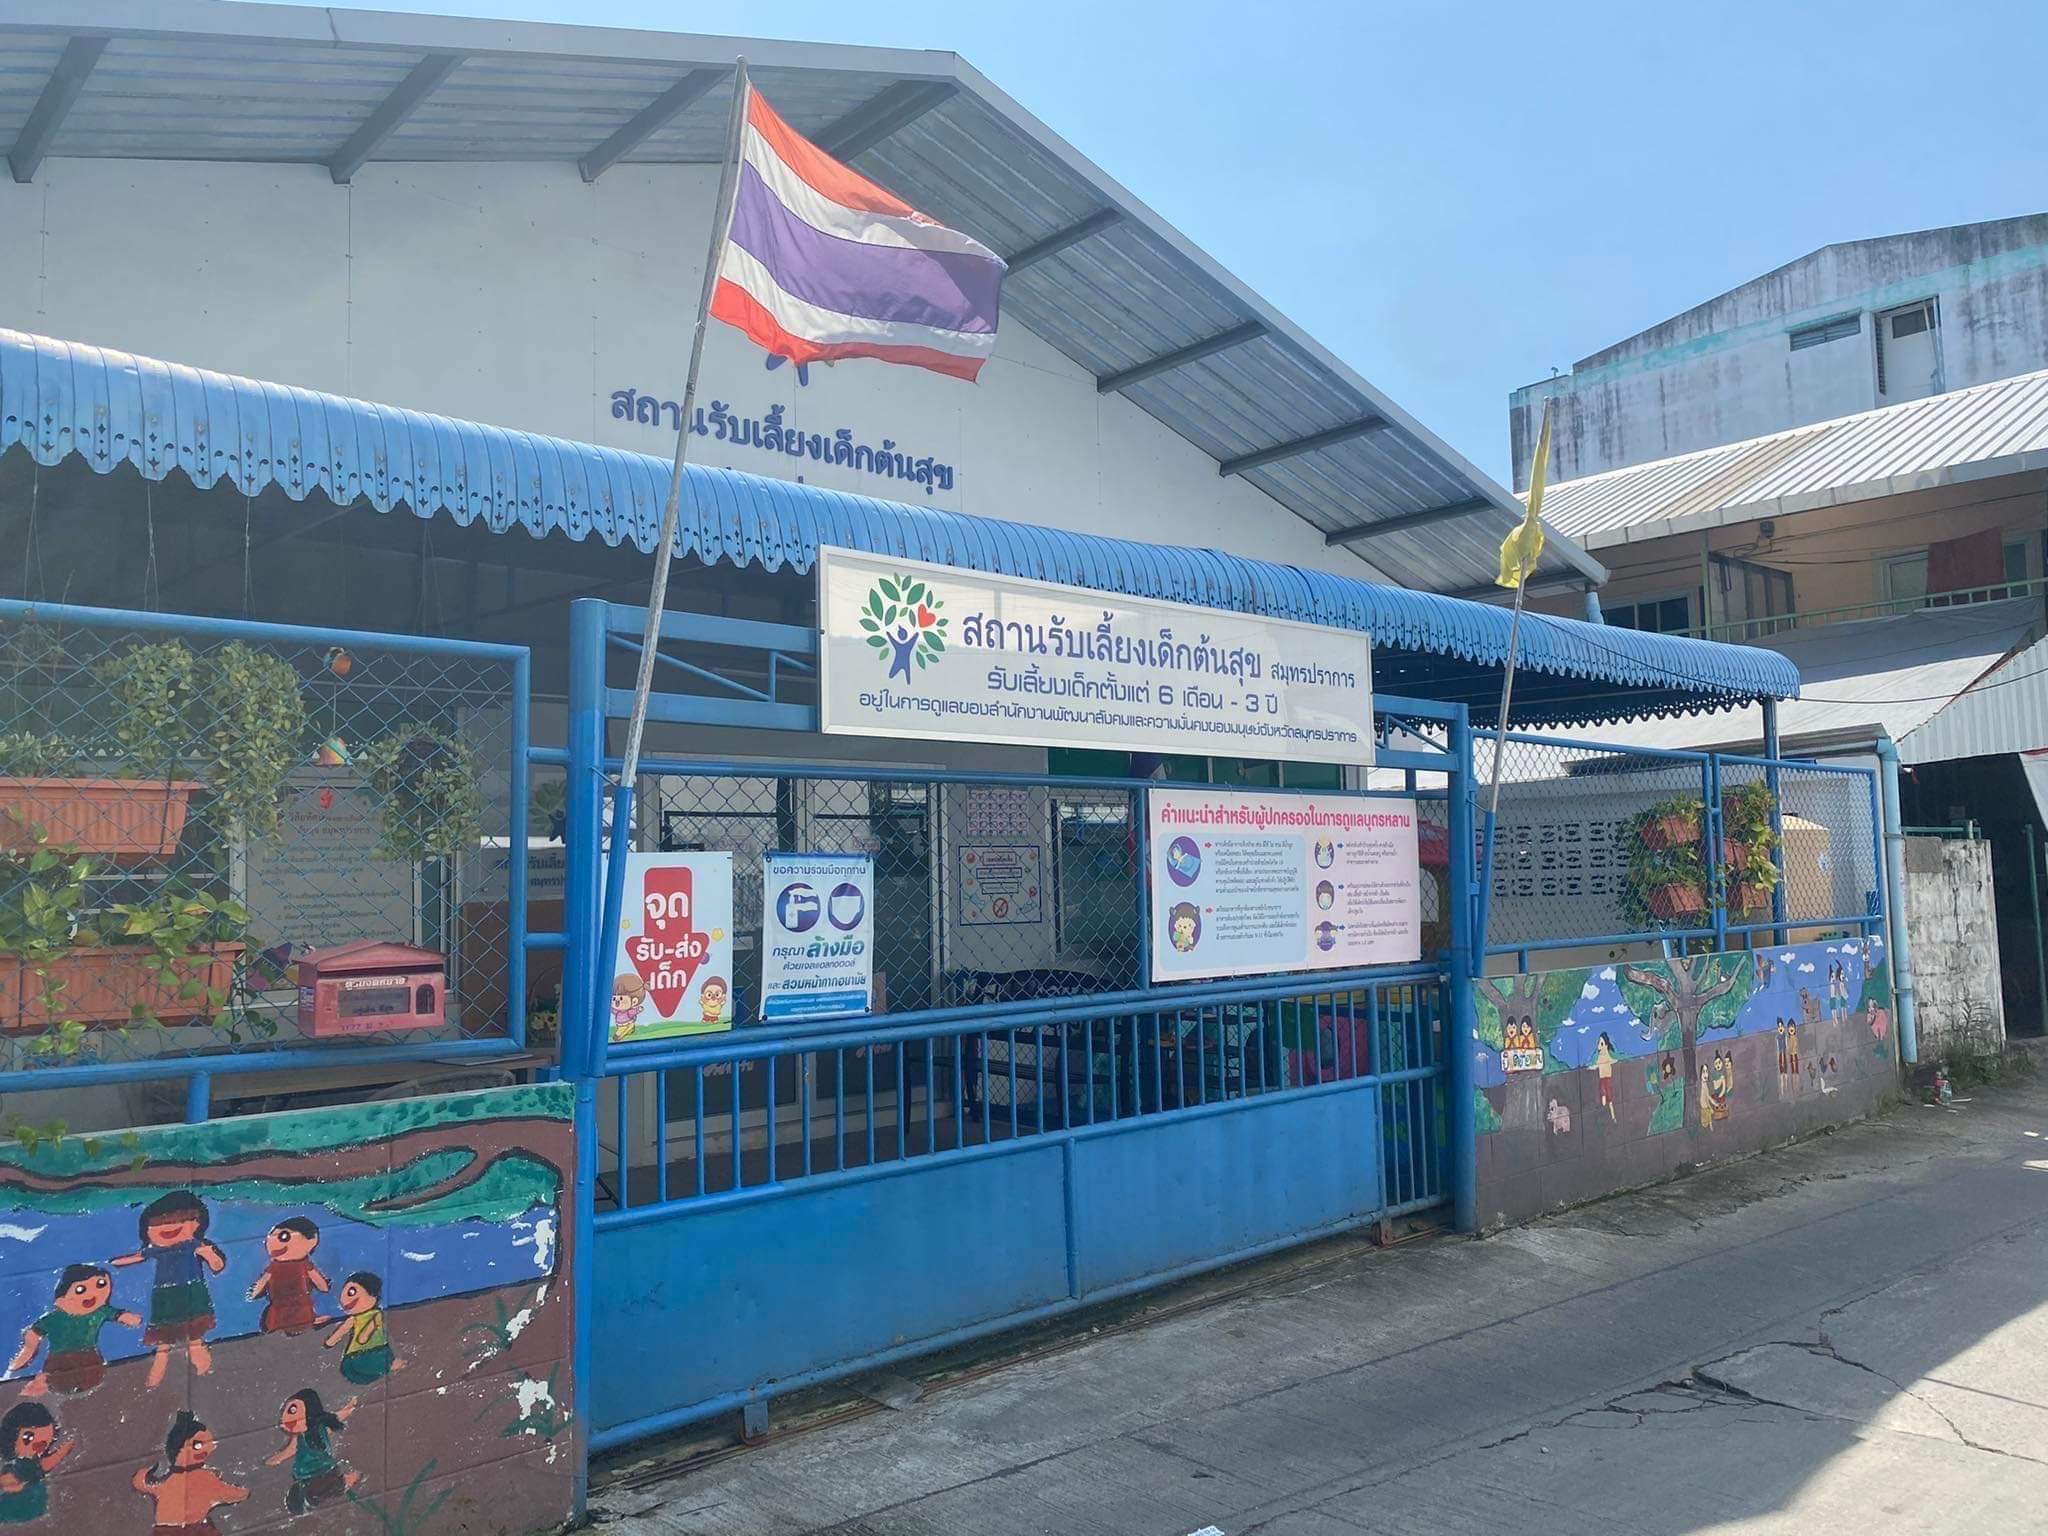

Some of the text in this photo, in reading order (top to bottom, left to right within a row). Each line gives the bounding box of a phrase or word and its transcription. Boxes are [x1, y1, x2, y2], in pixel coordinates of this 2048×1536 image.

[611, 387, 954, 495] สถานรับเลี้ยงเด็กต้นสุข
[962, 610, 1356, 689] สถานรับเลี้ยงเด็กต้นสุข สมุทรปราการ
[987, 663, 1150, 704] รับเลี้ยงเด็กตั้งแต่
[1159, 685, 1174, 704] 6
[1183, 687, 1223, 710] เดือน
[1246, 694, 1259, 713] 3
[1265, 693, 1279, 714] ปี
[1161, 802, 1411, 831] คำแนะนำสำหรับผู้ปกครองในการดูแลบุตรหลาน
[645, 891, 689, 930] จุด
[635, 933, 702, 961] รับ-ส่ง
[773, 934, 865, 959] กรุณา ล้างมือ
[649, 960, 687, 991] เด็ก
